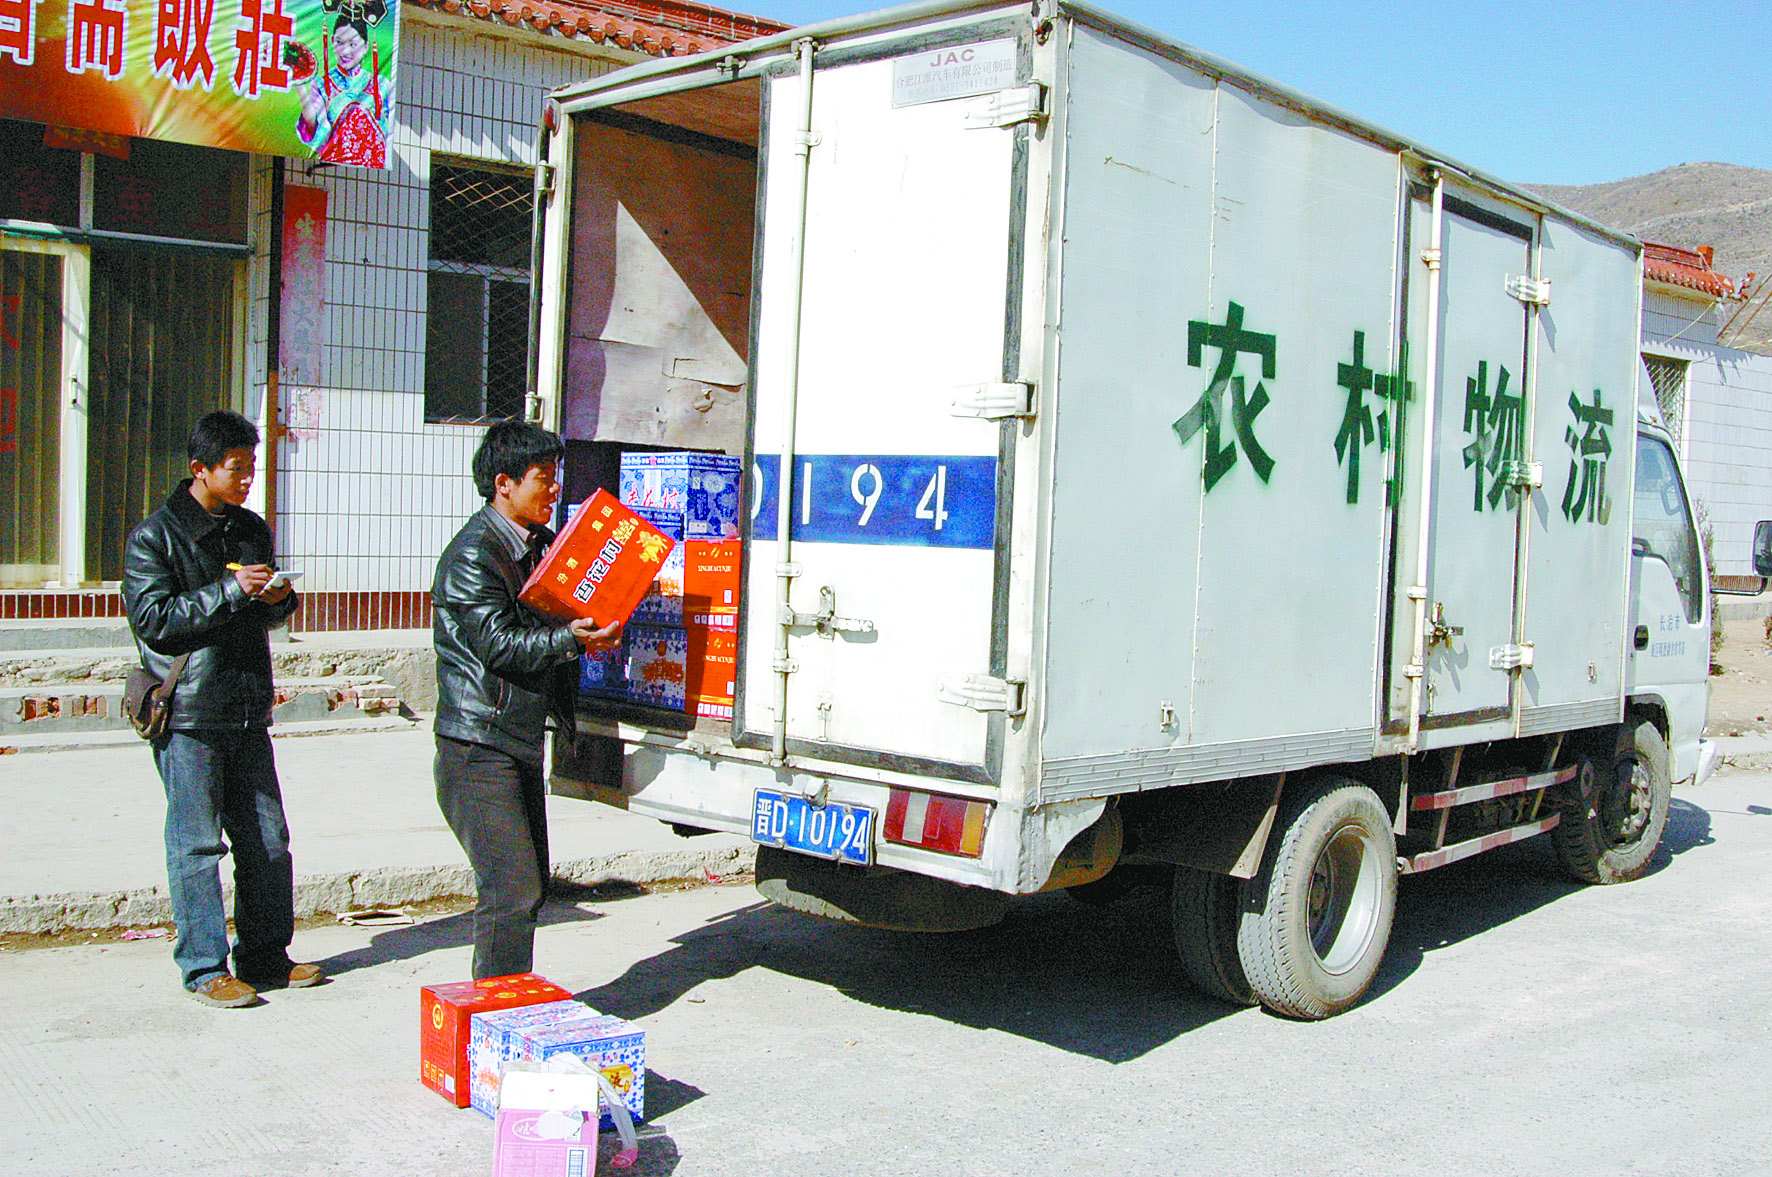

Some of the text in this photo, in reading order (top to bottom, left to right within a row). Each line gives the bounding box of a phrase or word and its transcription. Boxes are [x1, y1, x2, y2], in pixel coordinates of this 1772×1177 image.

[930, 48, 975, 67] JAC
[1172, 300, 1613, 527] 农村物流
